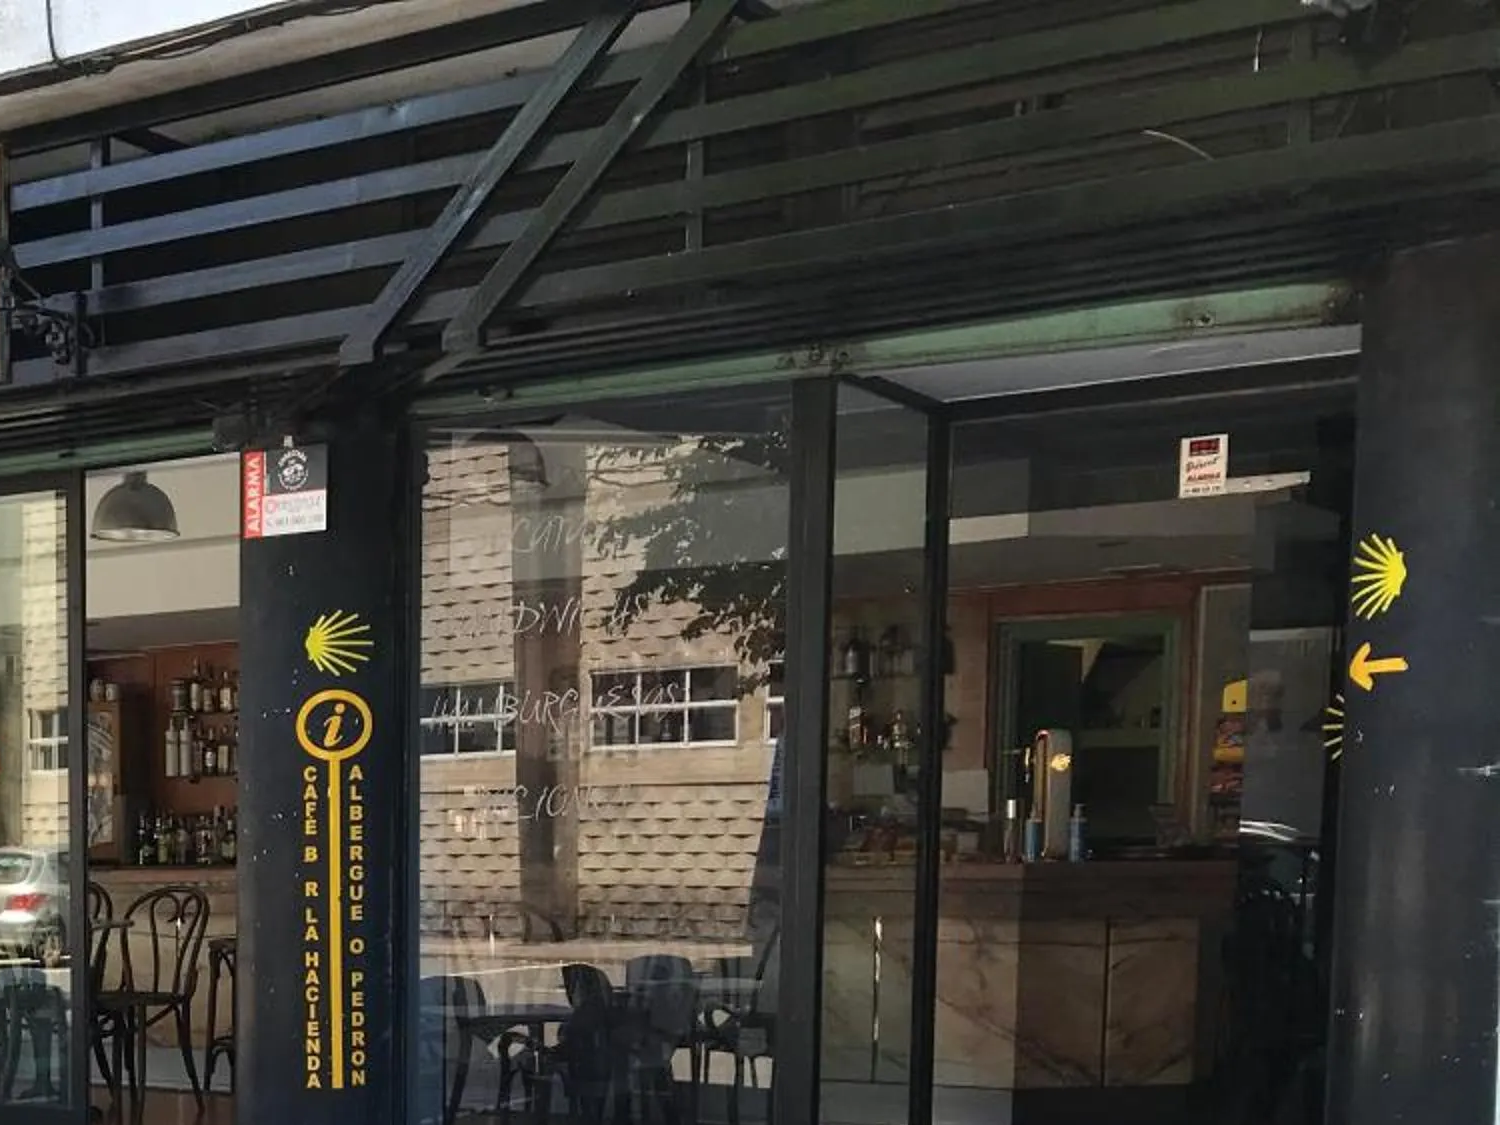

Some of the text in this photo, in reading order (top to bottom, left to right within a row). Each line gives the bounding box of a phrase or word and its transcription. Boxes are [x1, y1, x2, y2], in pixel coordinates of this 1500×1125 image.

[247, 456, 261, 533] ALARMA
[303, 765, 318, 835] CAFE
[305, 907, 320, 941] LA
[349, 764, 366, 1087] ALBERGUE O PEDRON
[305, 952, 322, 1089] HACIENDA
